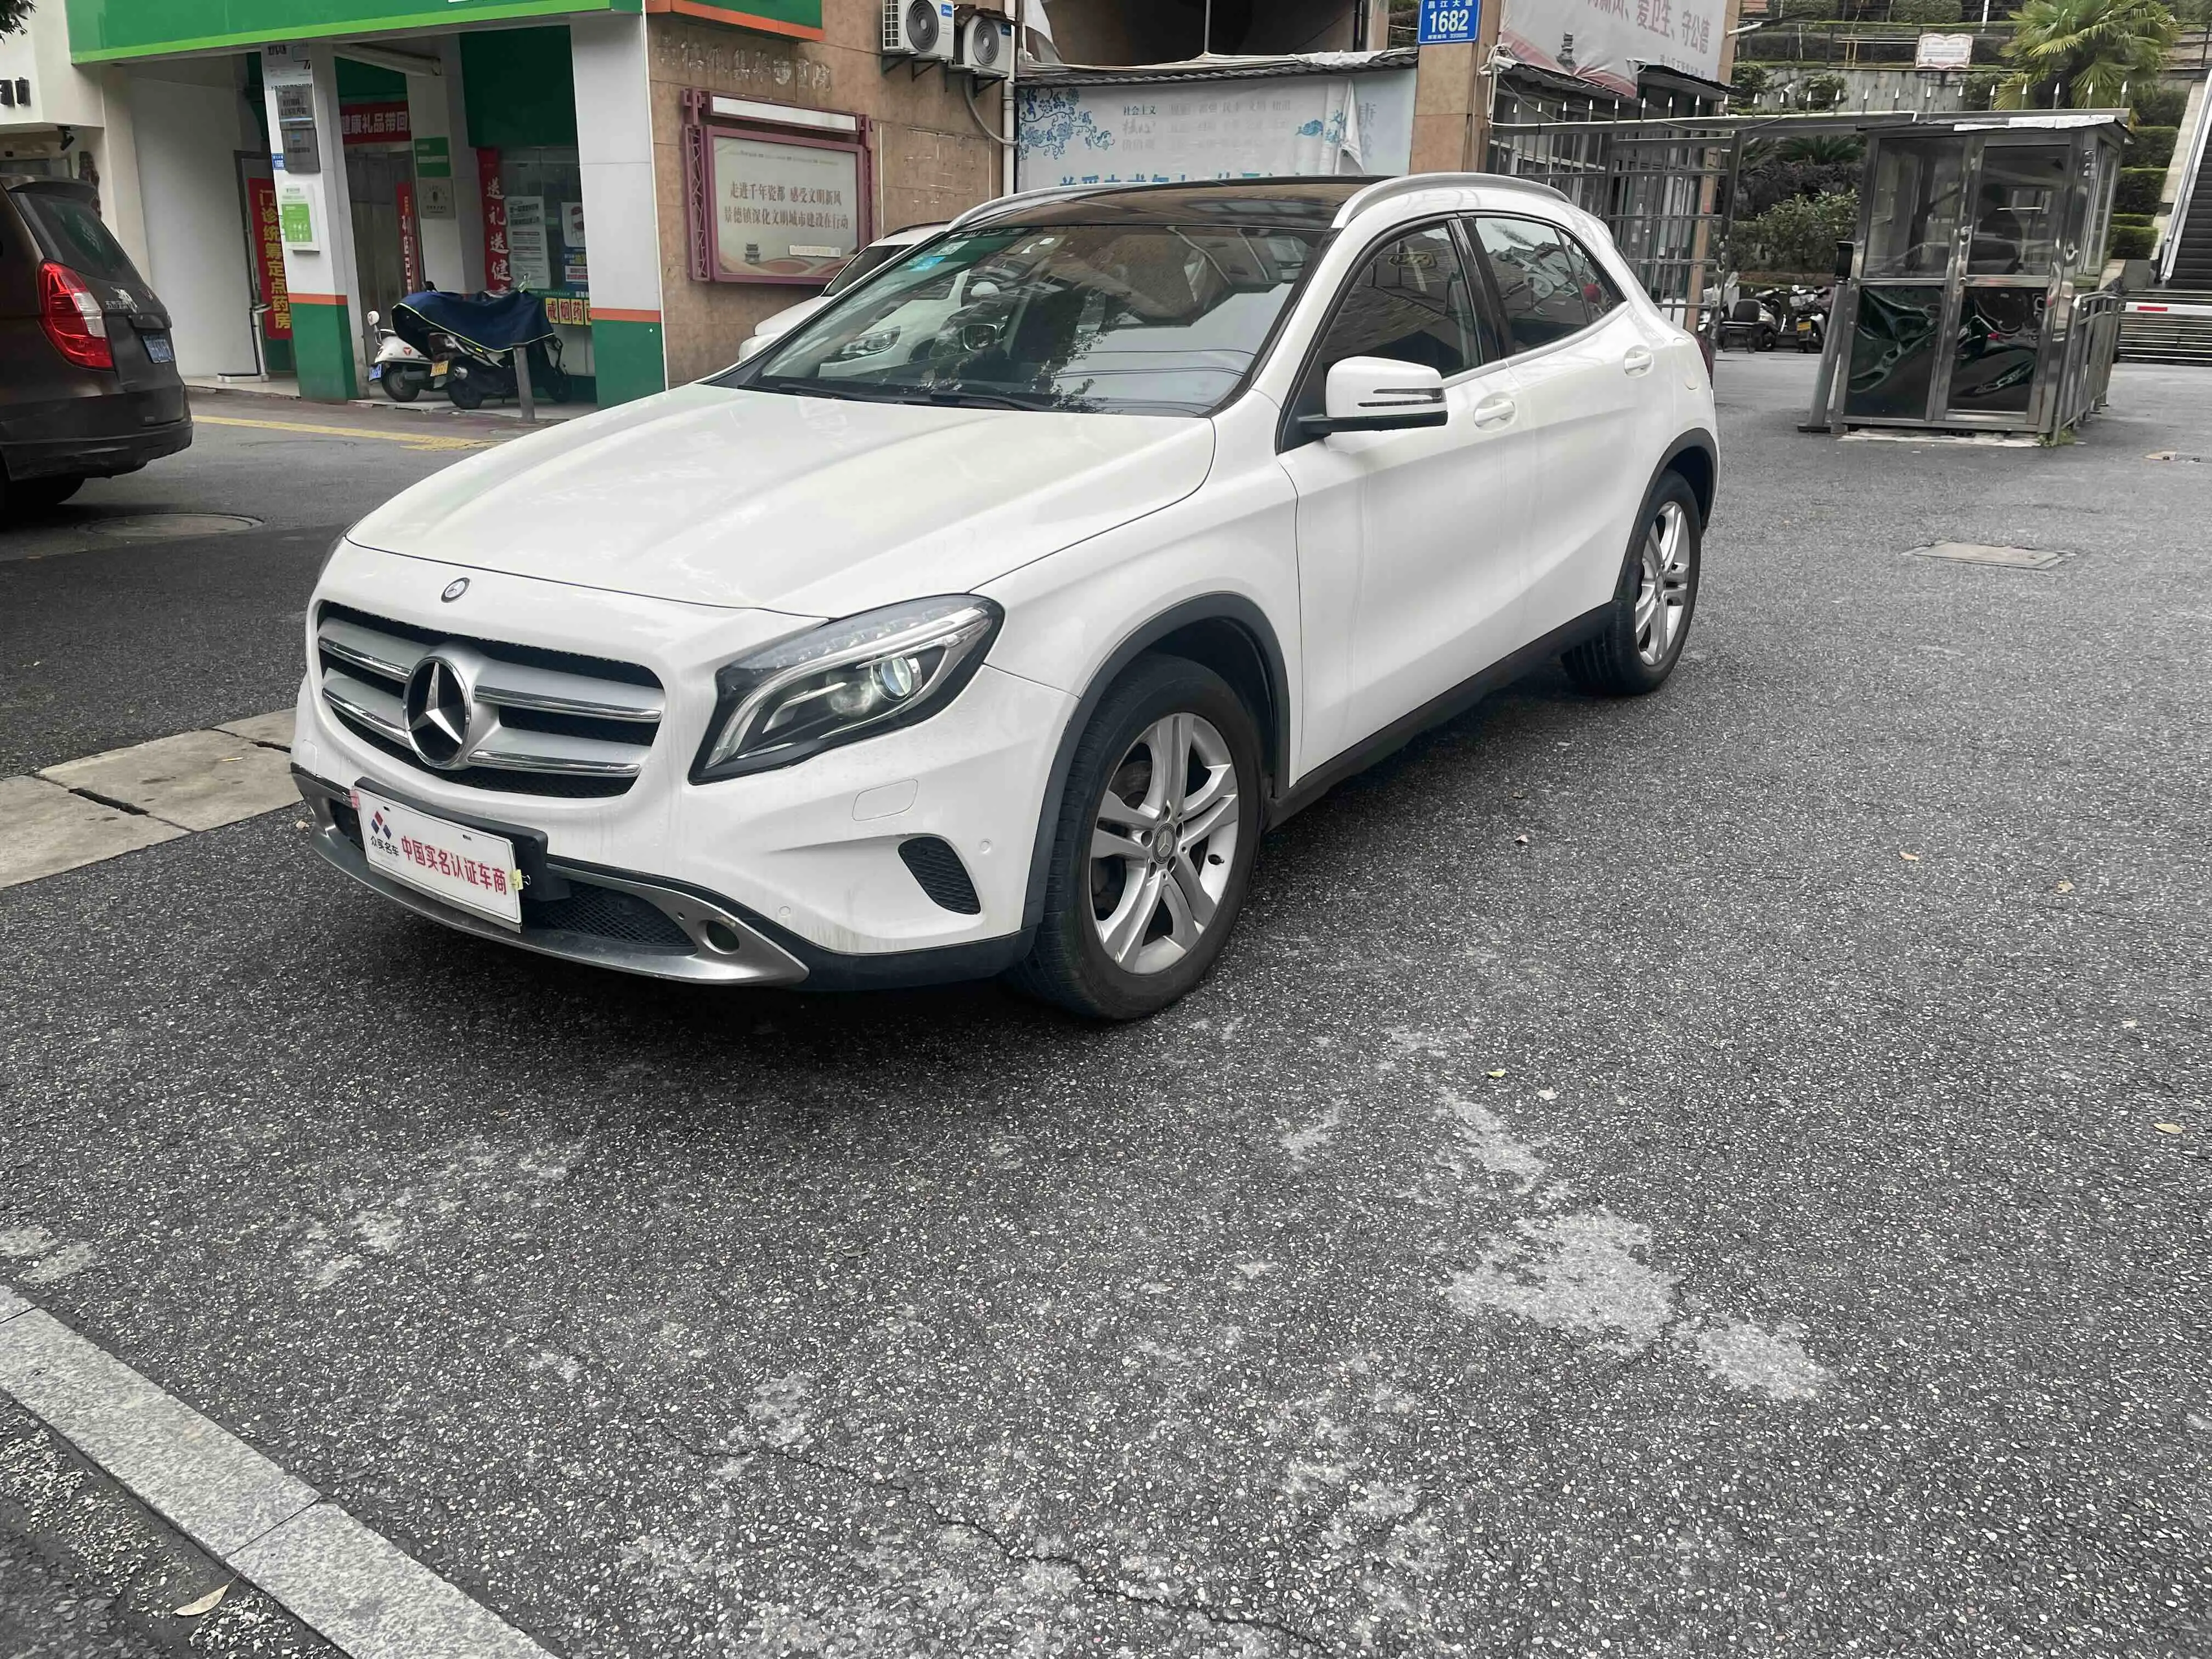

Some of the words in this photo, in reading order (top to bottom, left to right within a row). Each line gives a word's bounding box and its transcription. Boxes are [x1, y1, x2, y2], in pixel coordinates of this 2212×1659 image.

[1430, 9, 1469, 33] 1682
[1124, 104, 1156, 115] 社会主义
[730, 180, 785, 202] 走进千年瓷都
[370, 836, 400, 857] 众实名车
[401, 836, 507, 895] 中国实名认证车商
